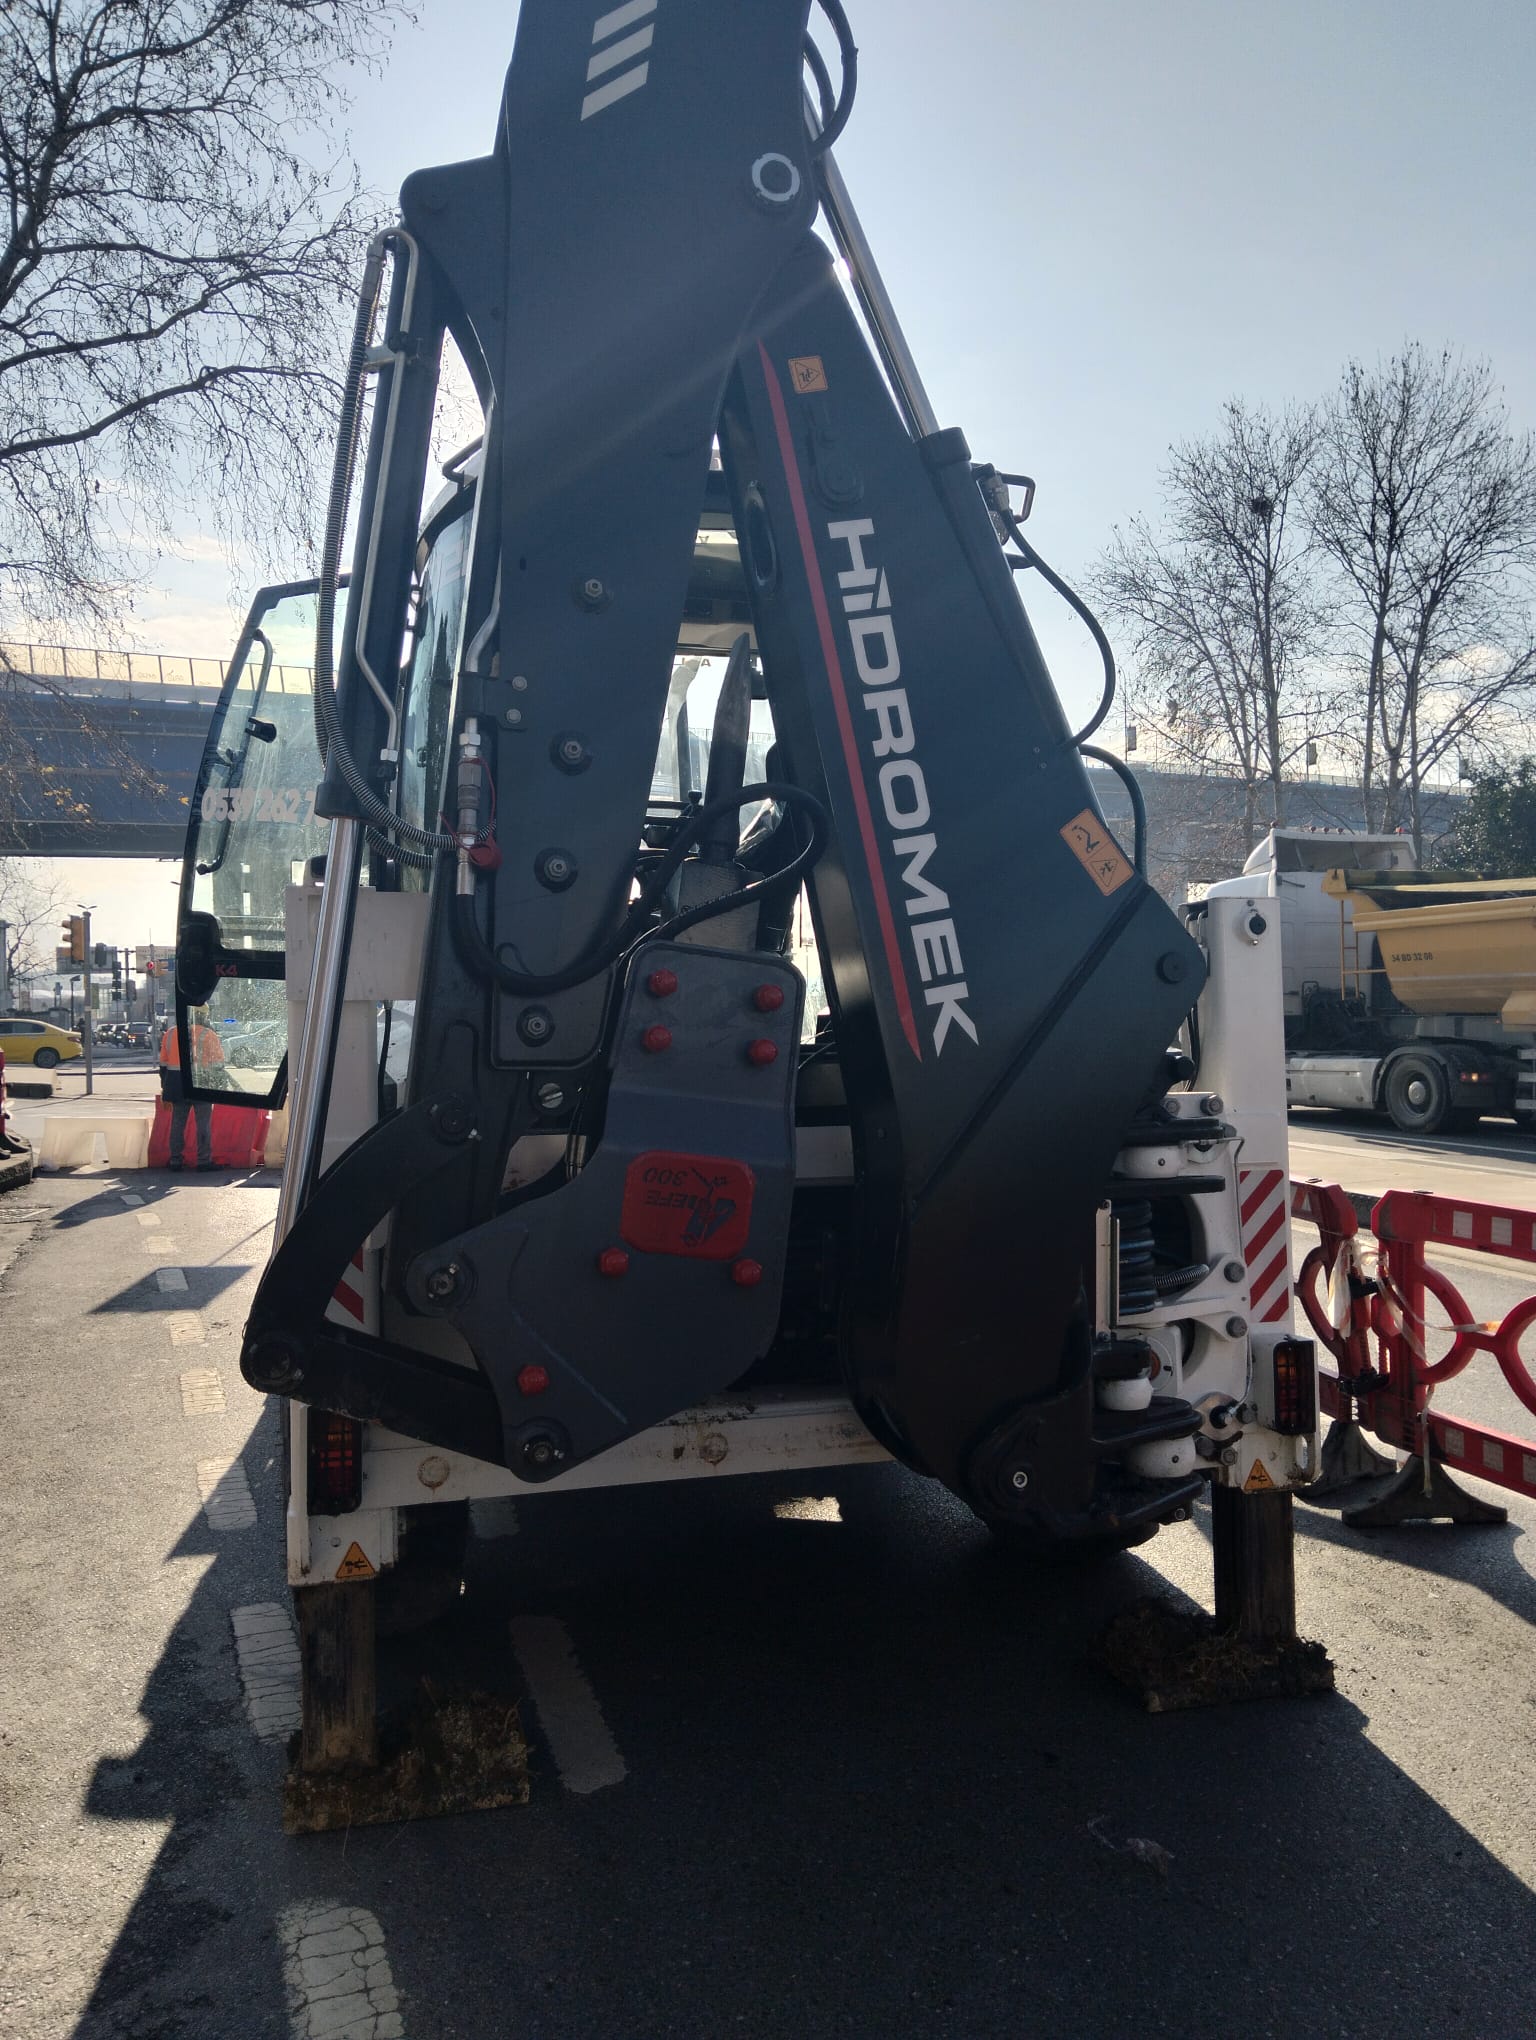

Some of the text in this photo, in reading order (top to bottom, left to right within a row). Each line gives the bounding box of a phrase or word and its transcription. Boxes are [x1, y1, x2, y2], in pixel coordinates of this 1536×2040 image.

[256, 788, 301, 824] 262
[215, 964, 238, 977] K4
[642, 1167, 688, 1187] 300
